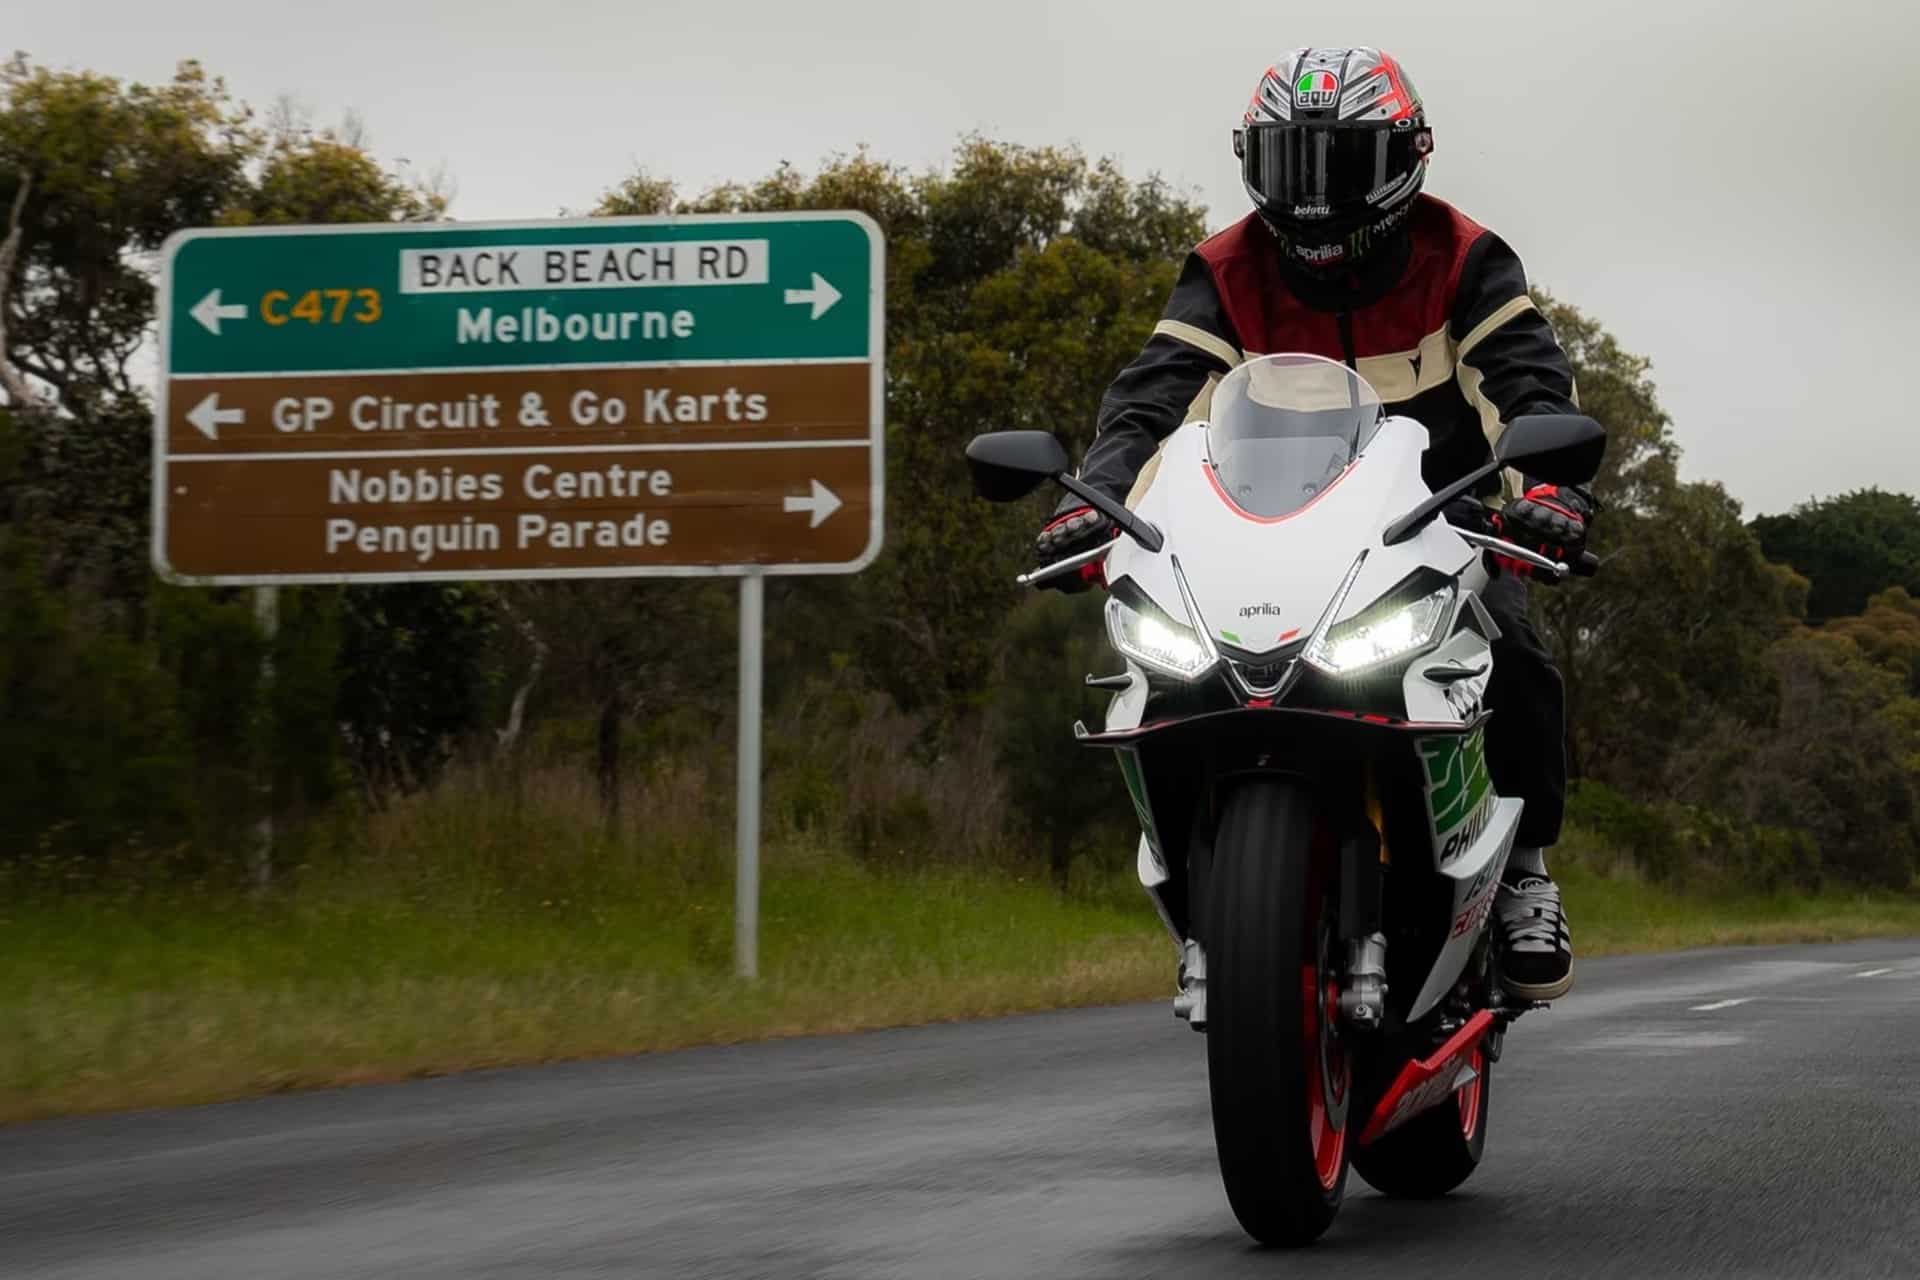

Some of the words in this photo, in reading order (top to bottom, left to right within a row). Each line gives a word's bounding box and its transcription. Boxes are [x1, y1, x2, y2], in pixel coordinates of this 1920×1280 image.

[418, 251, 520, 288] BACK
[545, 247, 676, 283] BEACH
[699, 245, 748, 279] RD
[261, 287, 382, 326] C473
[457, 307, 695, 344] Melbourne
[273, 397, 334, 433] GP
[350, 394, 500, 431] Circuit
[517, 391, 551, 427] &
[570, 390, 626, 426] Go
[644, 387, 768, 423] Karts
[330, 467, 504, 504] Nobbies
[523, 463, 673, 499] Centre
[327, 516, 500, 562] Penguin
[518, 513, 671, 549] Parade
[1239, 602, 1281, 618] aprilia
